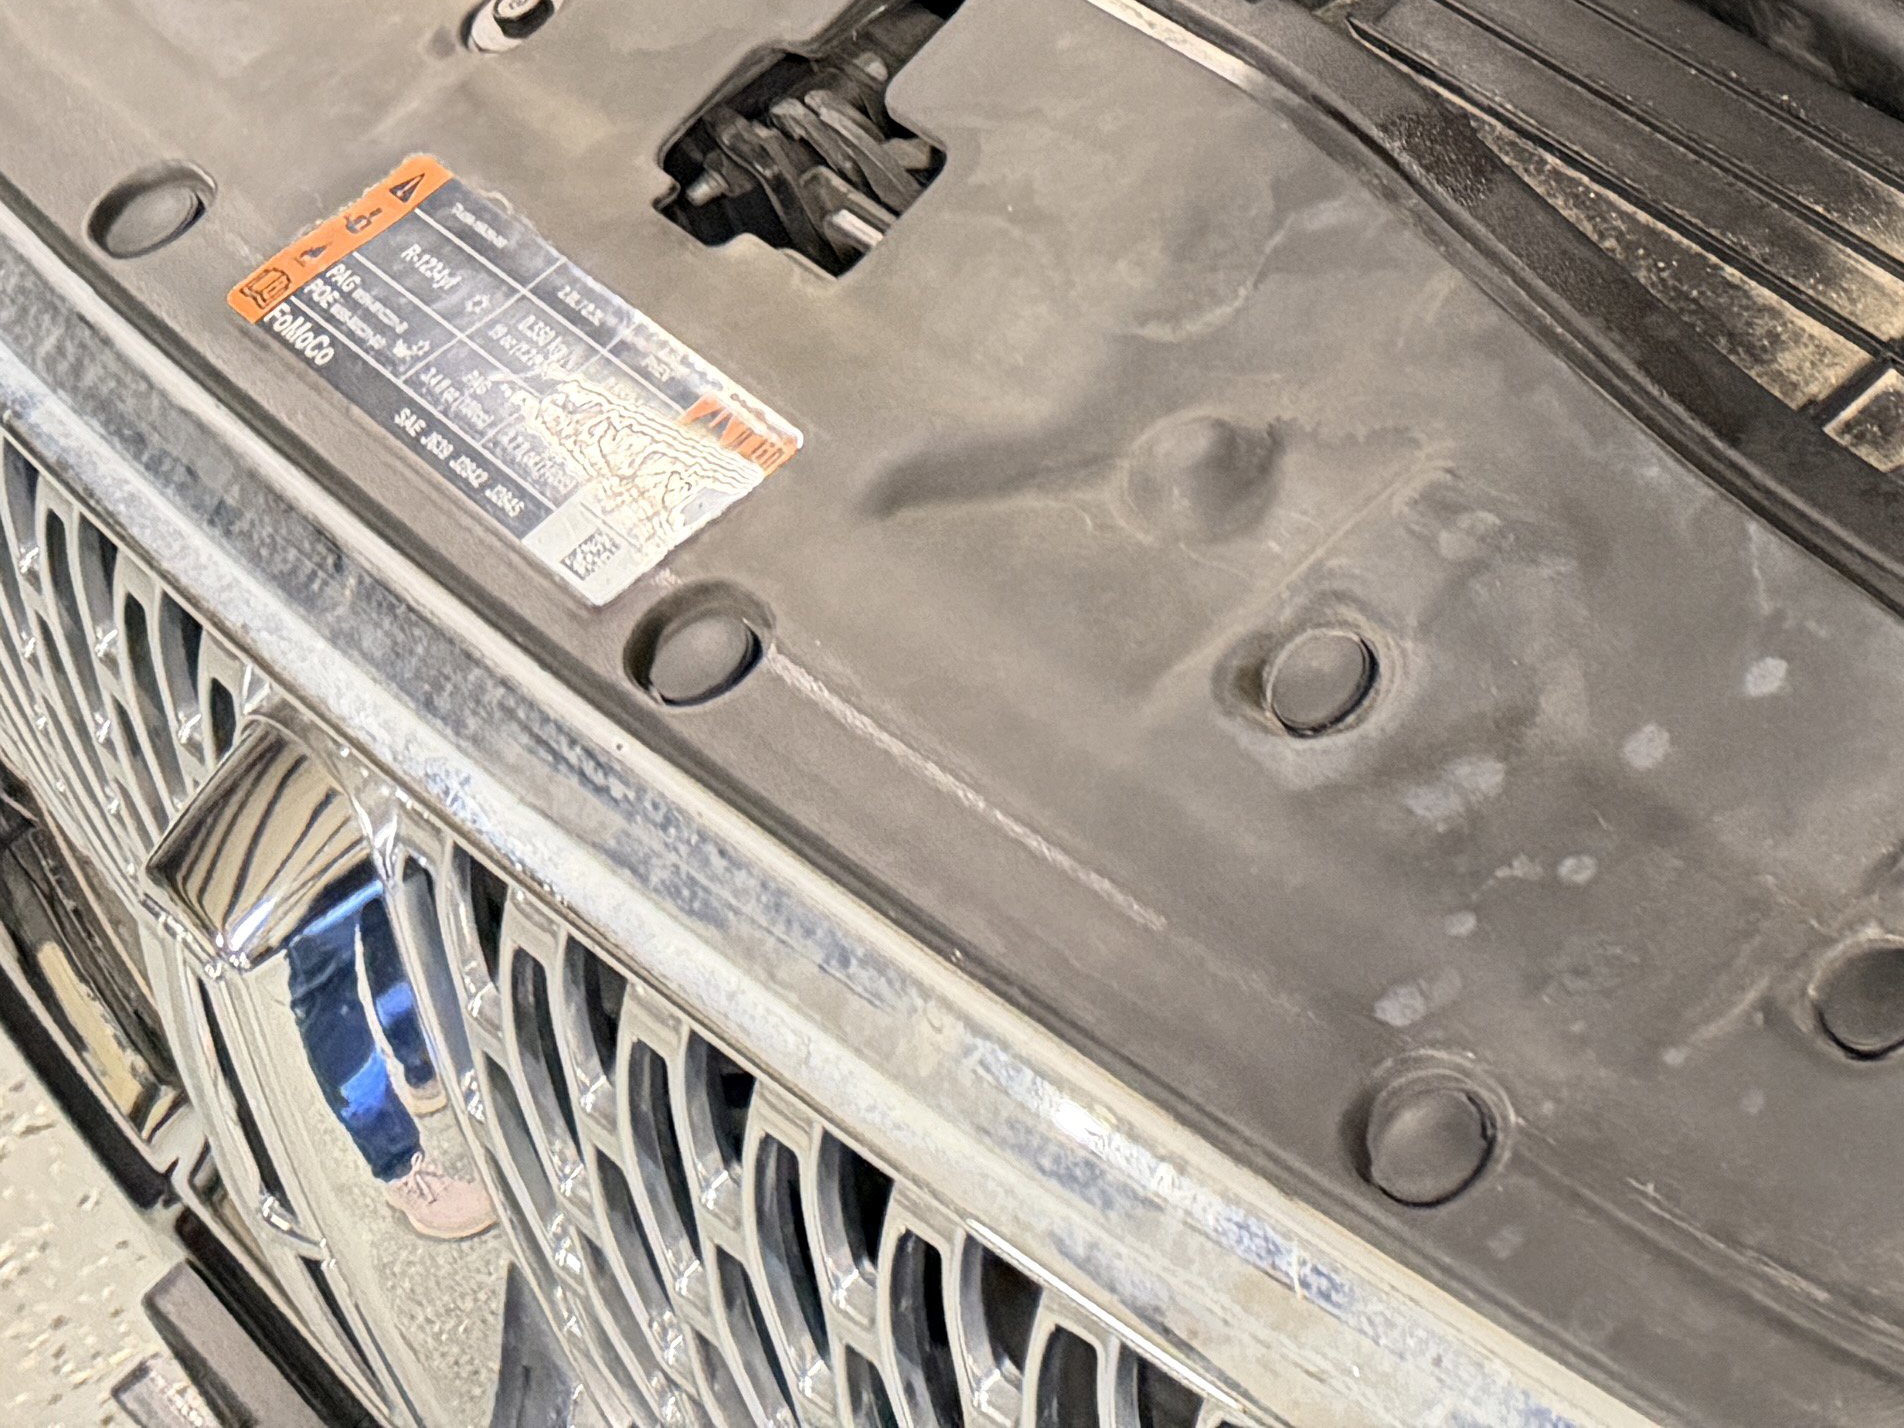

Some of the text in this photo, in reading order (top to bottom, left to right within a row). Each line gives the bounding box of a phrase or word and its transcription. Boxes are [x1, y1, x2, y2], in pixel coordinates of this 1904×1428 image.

[325, 263, 361, 292] PAG
[400, 243, 462, 289] R-1234yf
[303, 277, 340, 308] POE
[263, 302, 334, 365] FoMoCo
[393, 407, 426, 437] SAE
